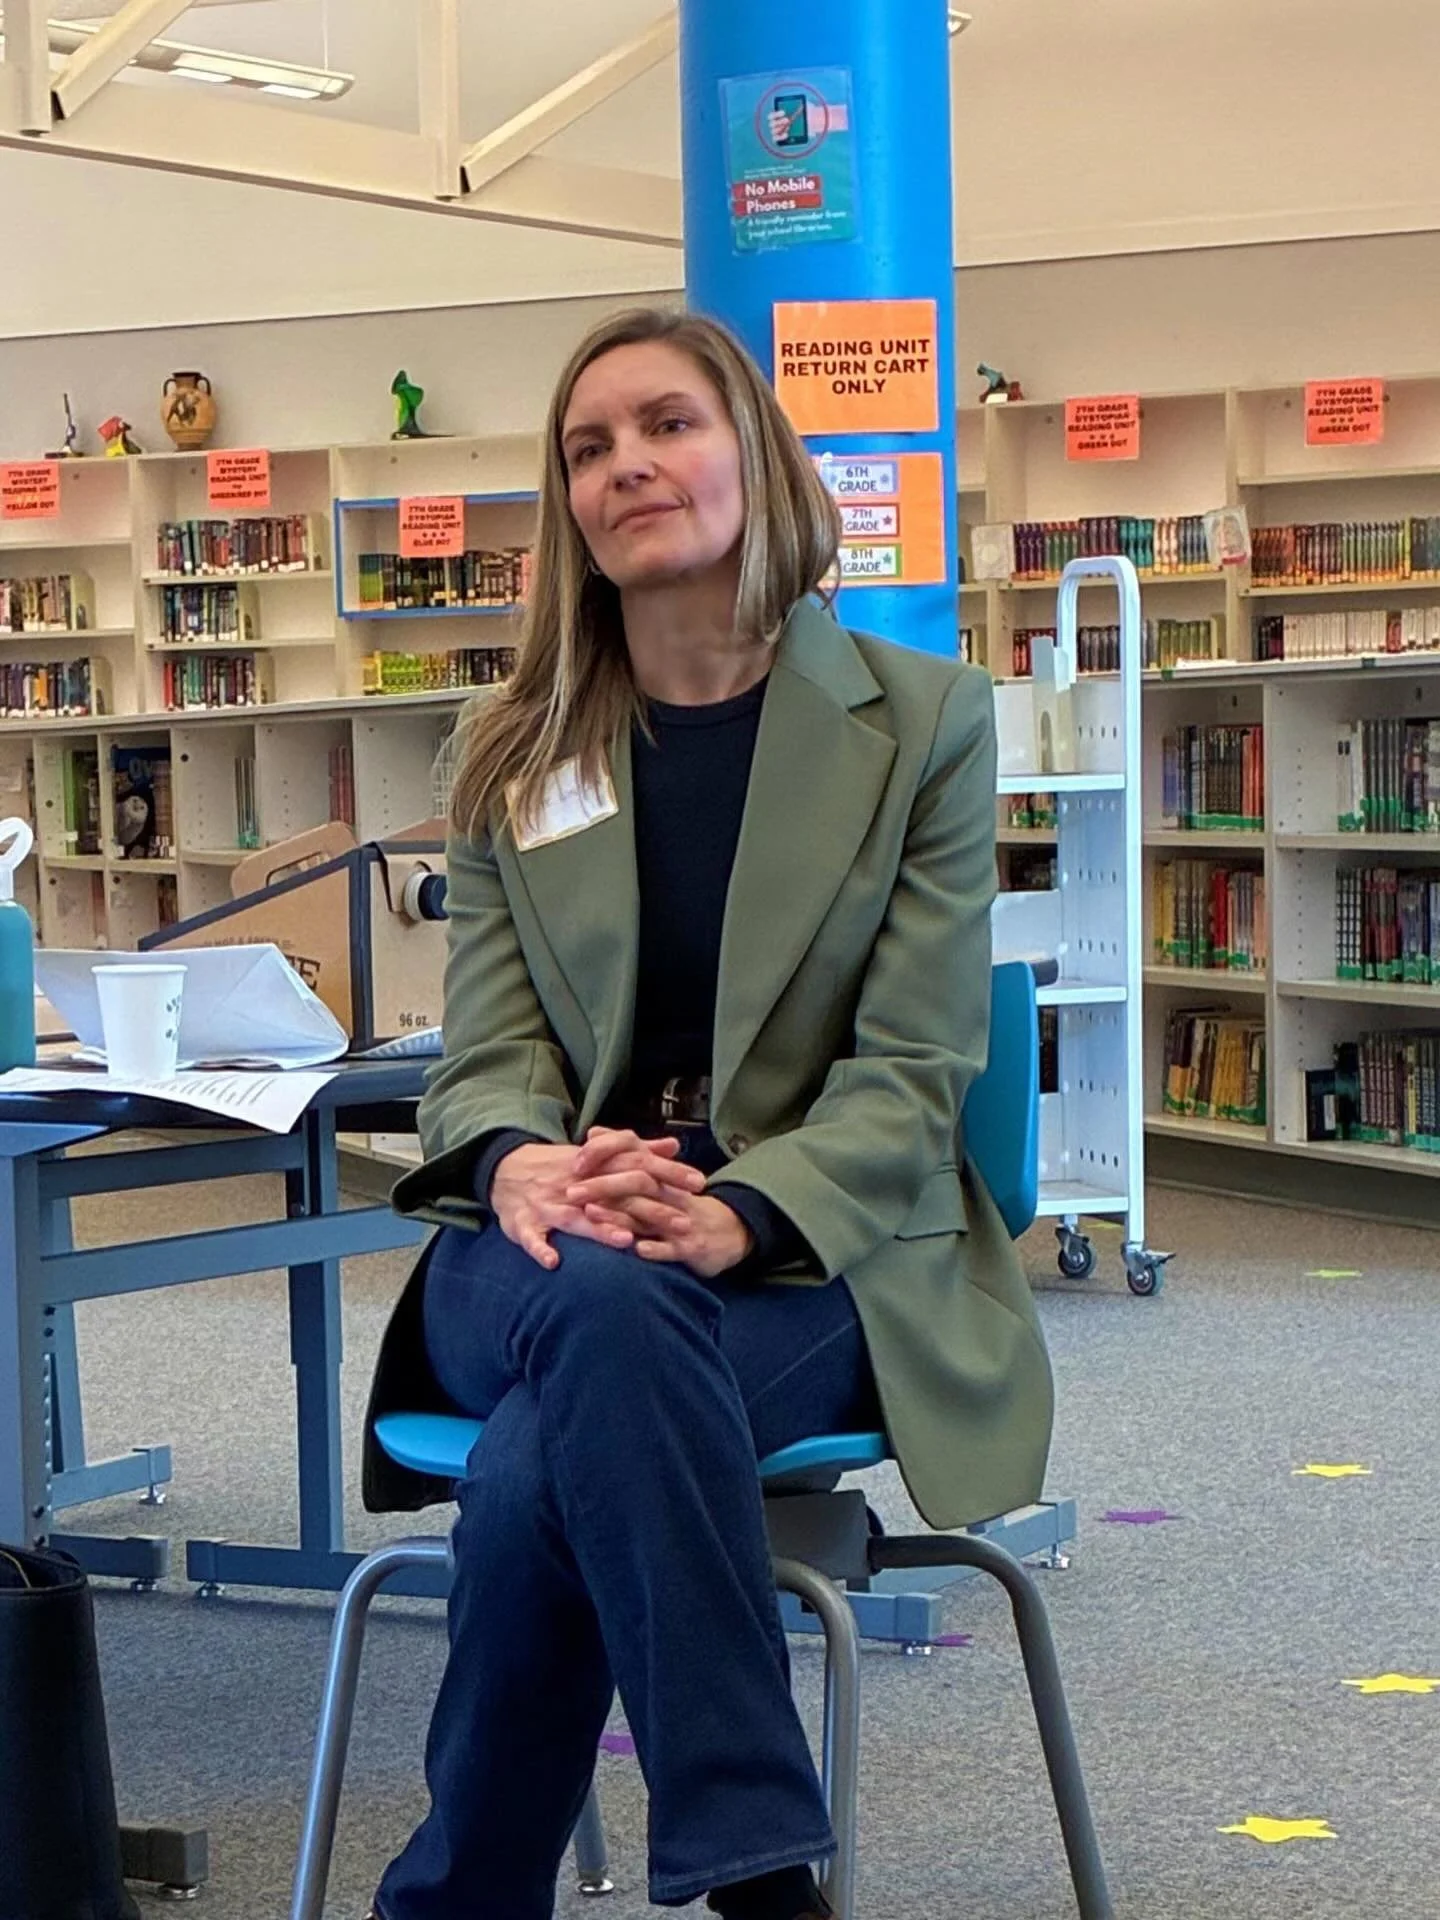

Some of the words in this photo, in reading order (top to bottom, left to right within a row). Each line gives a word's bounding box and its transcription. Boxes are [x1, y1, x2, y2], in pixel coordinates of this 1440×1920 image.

[745, 183, 765, 196] No
[767, 176, 816, 194] Mobile
[746, 199, 796, 214] Phones
[781, 340, 873, 357] READING
[880, 339, 930, 354] UNIT
[783, 360, 866, 376] RETURN
[874, 358, 929, 374] CART
[832, 379, 886, 394] ONLY
[1339, 386, 1372, 396] GRADE
[1315, 397, 1373, 406] DYSTOPIAN
[1097, 403, 1128, 412] GRADE
[1308, 406, 1354, 416] READING
[1356, 404, 1379, 414] UNIT
[1075, 412, 1129, 423] DYSTOPIAN
[1068, 422, 1112, 432] READING
[1114, 420, 1136, 430] UNIT
[1318, 425, 1350, 434] GREEN
[234, 456, 260, 465] GRADE
[25, 468, 51, 477] GRADE
[846, 466, 869, 478] 6TH
[210, 474, 246, 483] READING
[248, 473, 267, 481] UNIT
[2, 486, 37, 495] READING
[39, 484, 57, 492] UNIT
[838, 481, 878, 492] GRADE
[427, 504, 455, 513] GRADE
[852, 509, 873, 519] 7TH
[408, 513, 456, 521] DYSTOPIAN
[402, 522, 440, 530] READING
[441, 521, 461, 529] UNIT
[845, 521, 880, 531] GRADE
[851, 549, 873, 560] 8TH
[843, 562, 881, 573] GRADE
[399, 1013, 413, 1027] 96
